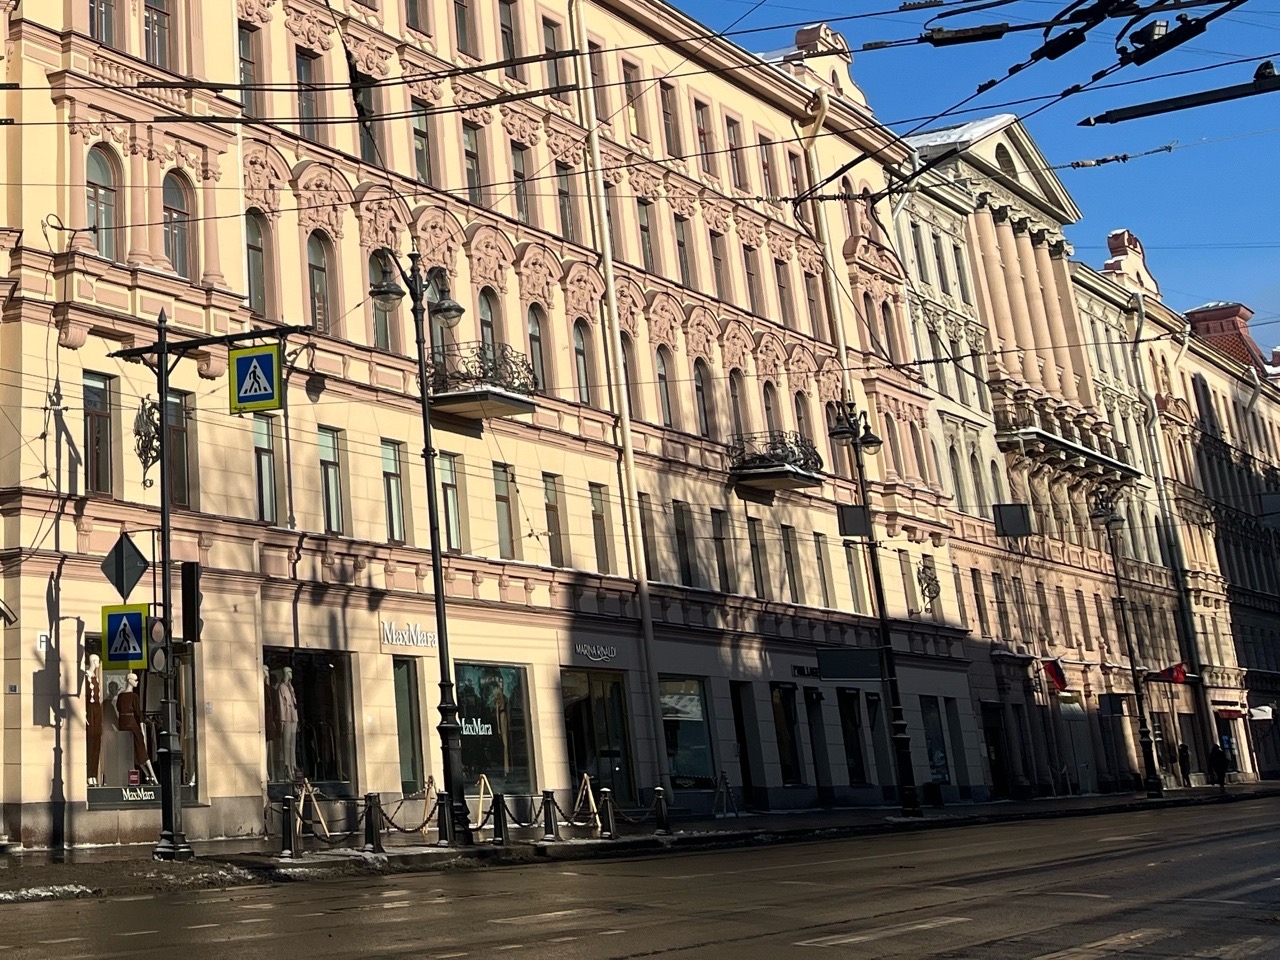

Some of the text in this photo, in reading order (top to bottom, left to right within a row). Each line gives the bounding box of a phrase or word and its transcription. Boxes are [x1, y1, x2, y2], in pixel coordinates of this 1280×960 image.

[380, 620, 438, 648] MaxMara
[575, 643, 616, 660] MARINA RINALDI
[121, 787, 156, 801] MaxMara
